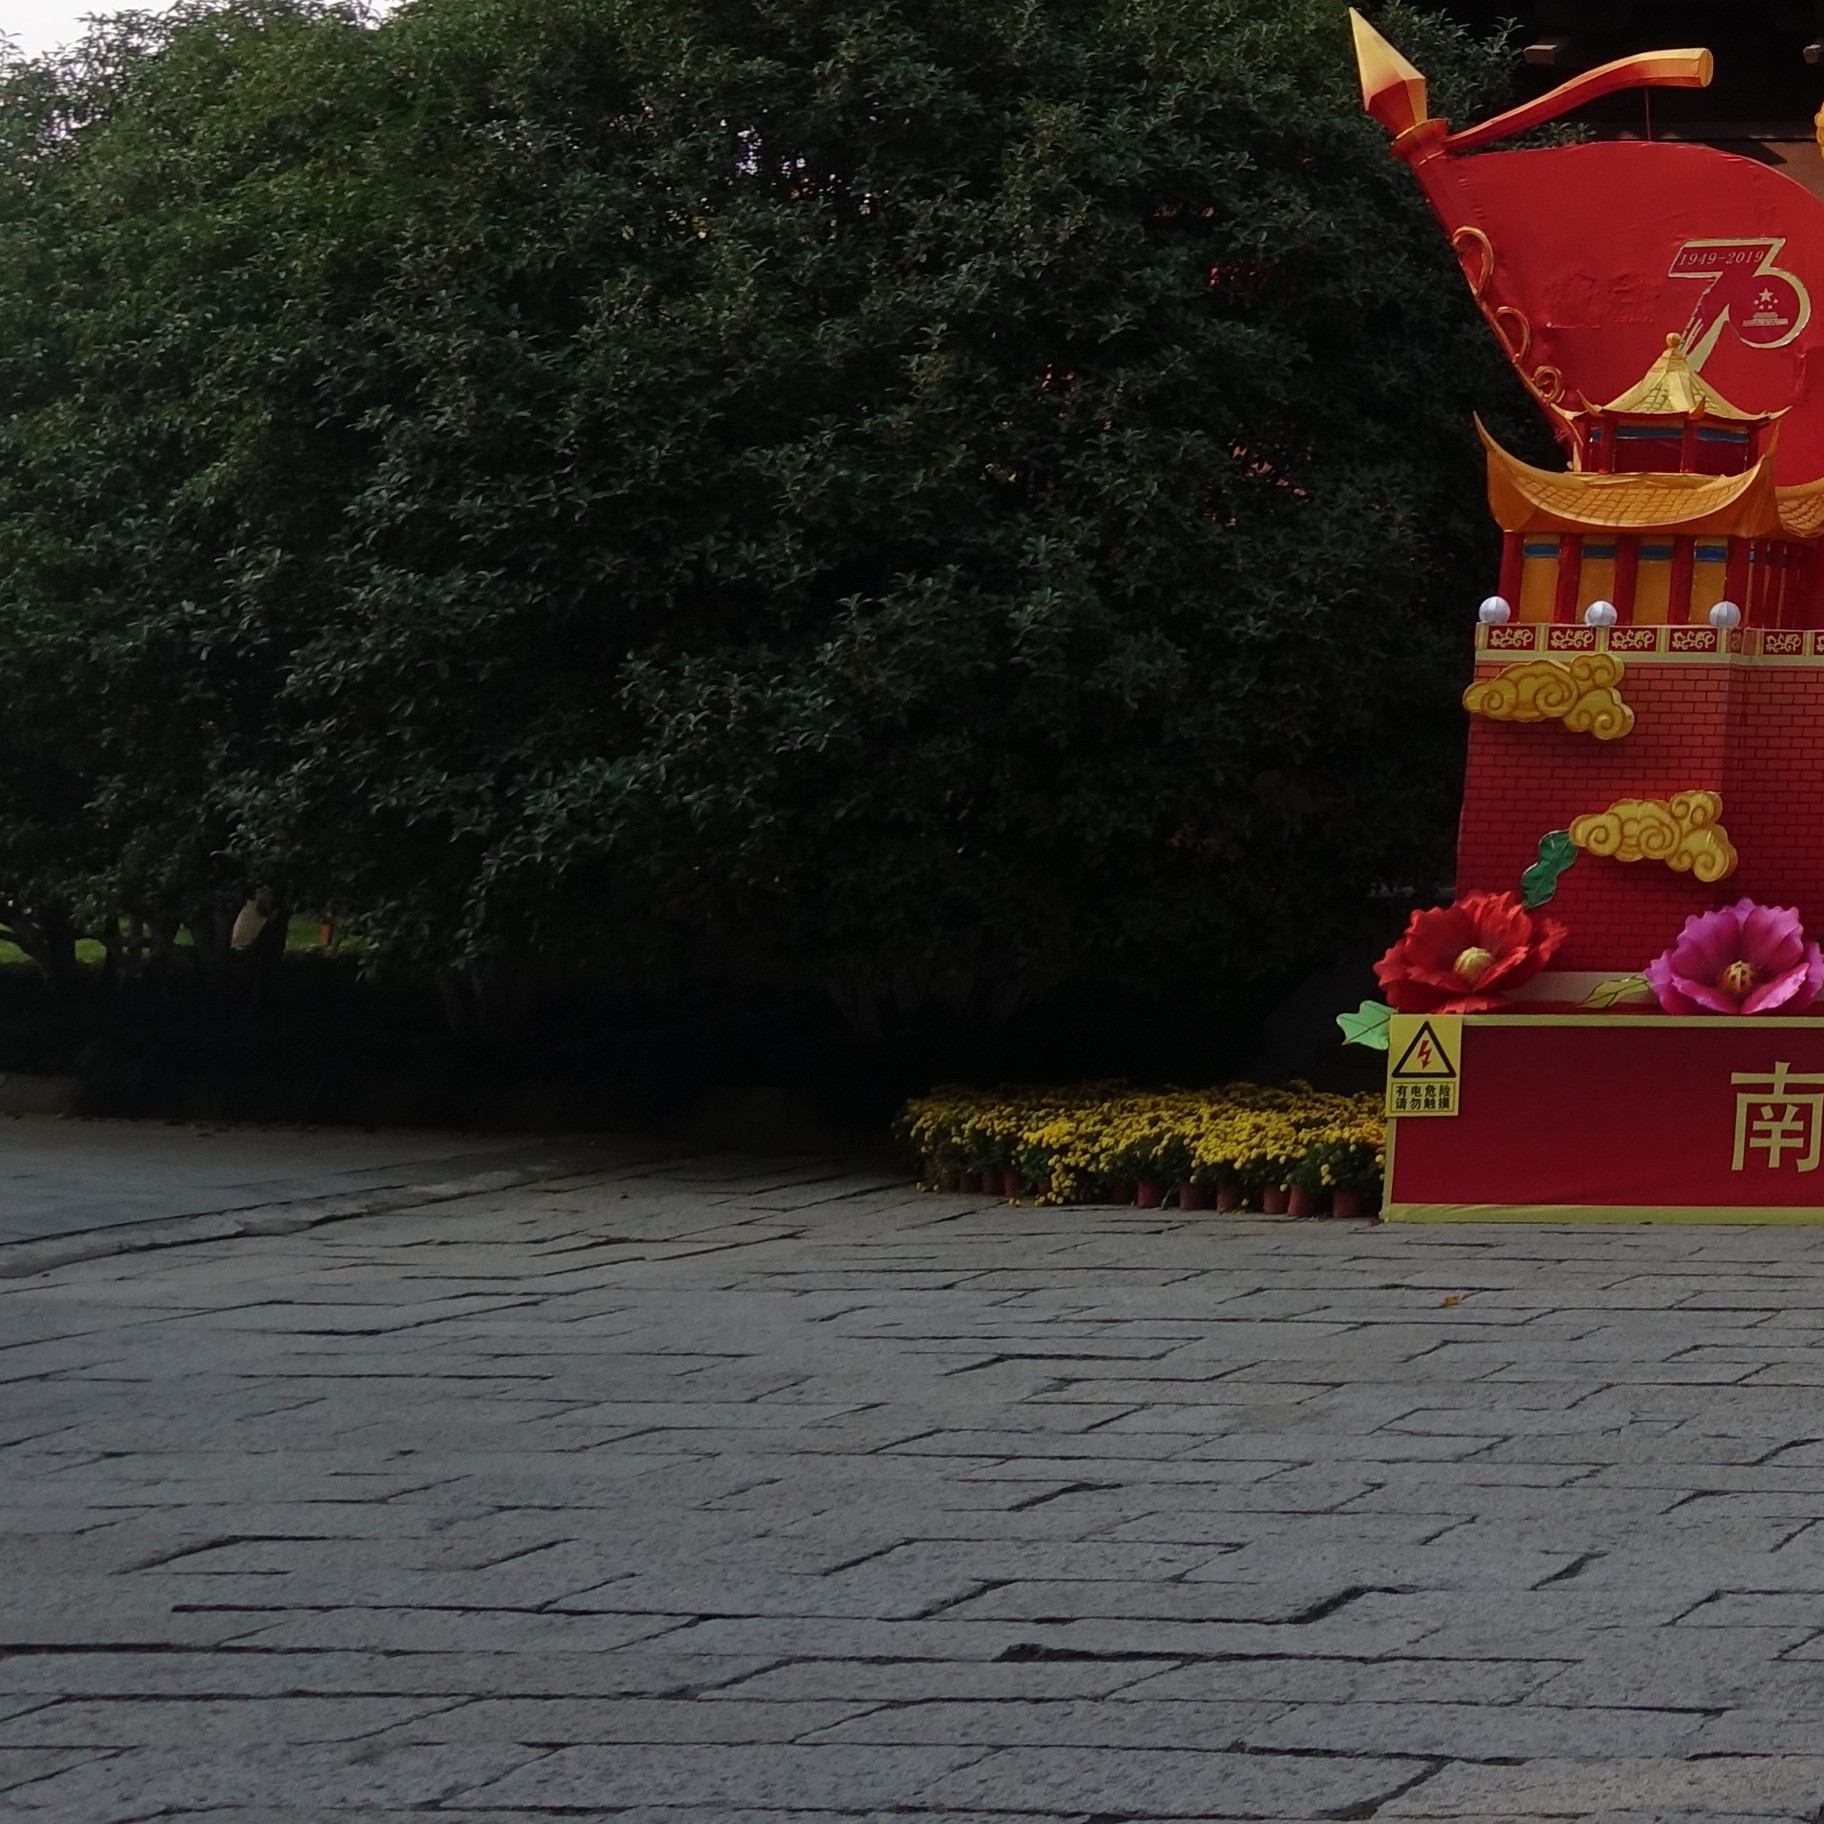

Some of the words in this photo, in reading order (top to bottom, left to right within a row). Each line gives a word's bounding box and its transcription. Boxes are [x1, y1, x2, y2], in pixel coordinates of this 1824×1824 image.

[1678, 250, 1766, 267] 1949-2019
[1396, 1084, 1451, 1097] 有电危险
[1395, 1097, 1450, 1110] 请勿触摸
